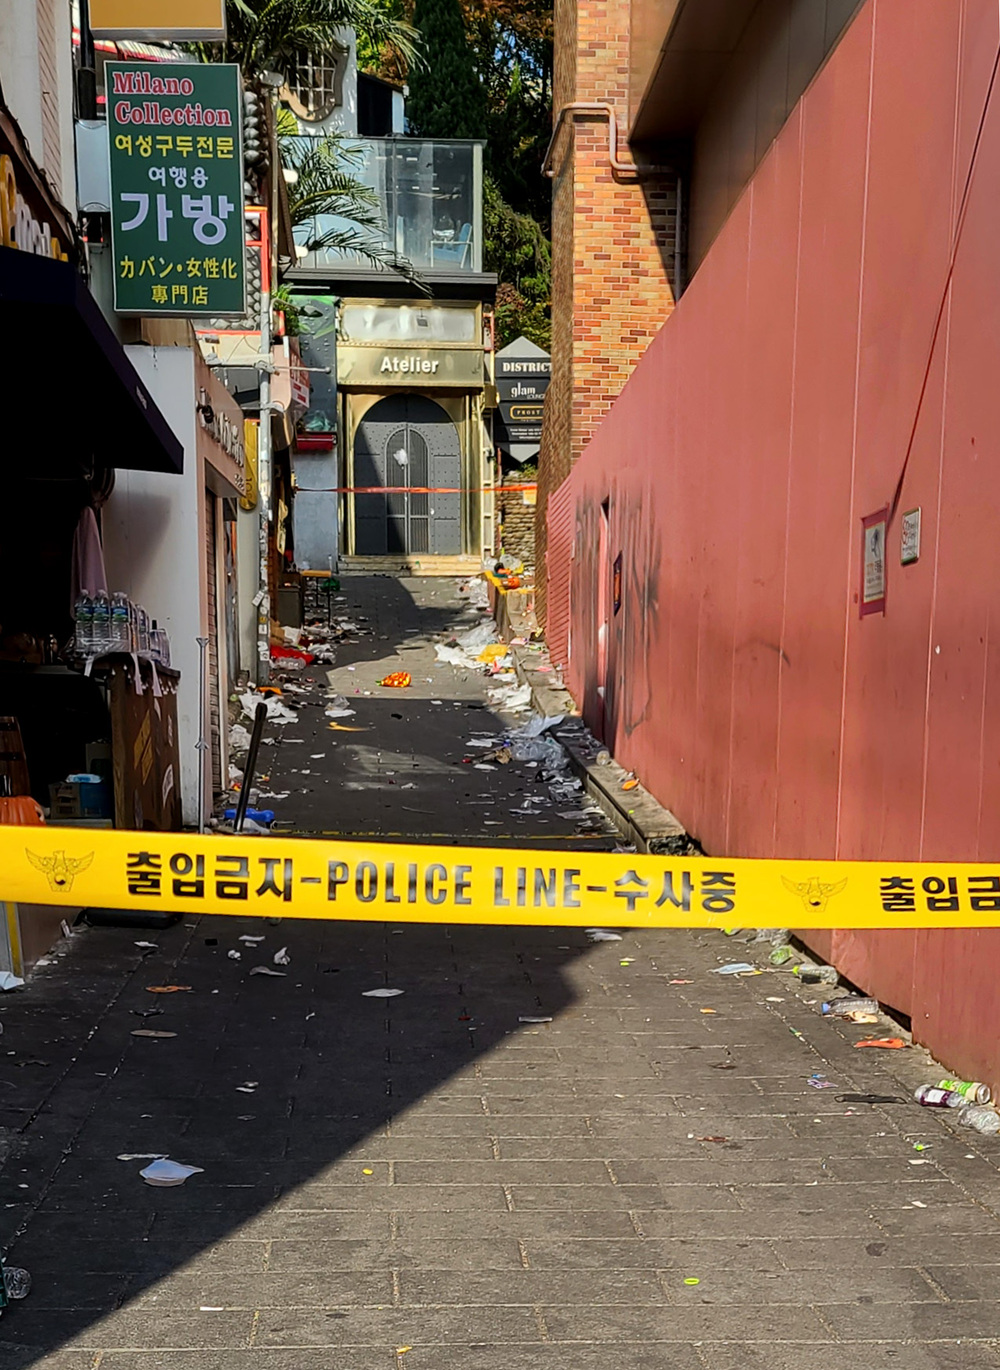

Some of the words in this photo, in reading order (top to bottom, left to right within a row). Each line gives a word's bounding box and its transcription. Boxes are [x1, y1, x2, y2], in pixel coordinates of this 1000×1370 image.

[113, 72, 194, 95] Milano
[115, 101, 232, 126] Collection
[115, 134, 234, 158] 여성구두전문
[148, 166, 209, 189] 여행용
[120, 193, 235, 246] 가방
[151, 285, 209, 305] 專門店
[380, 356, 439, 374] Atelier
[511, 382, 536, 398] glam
